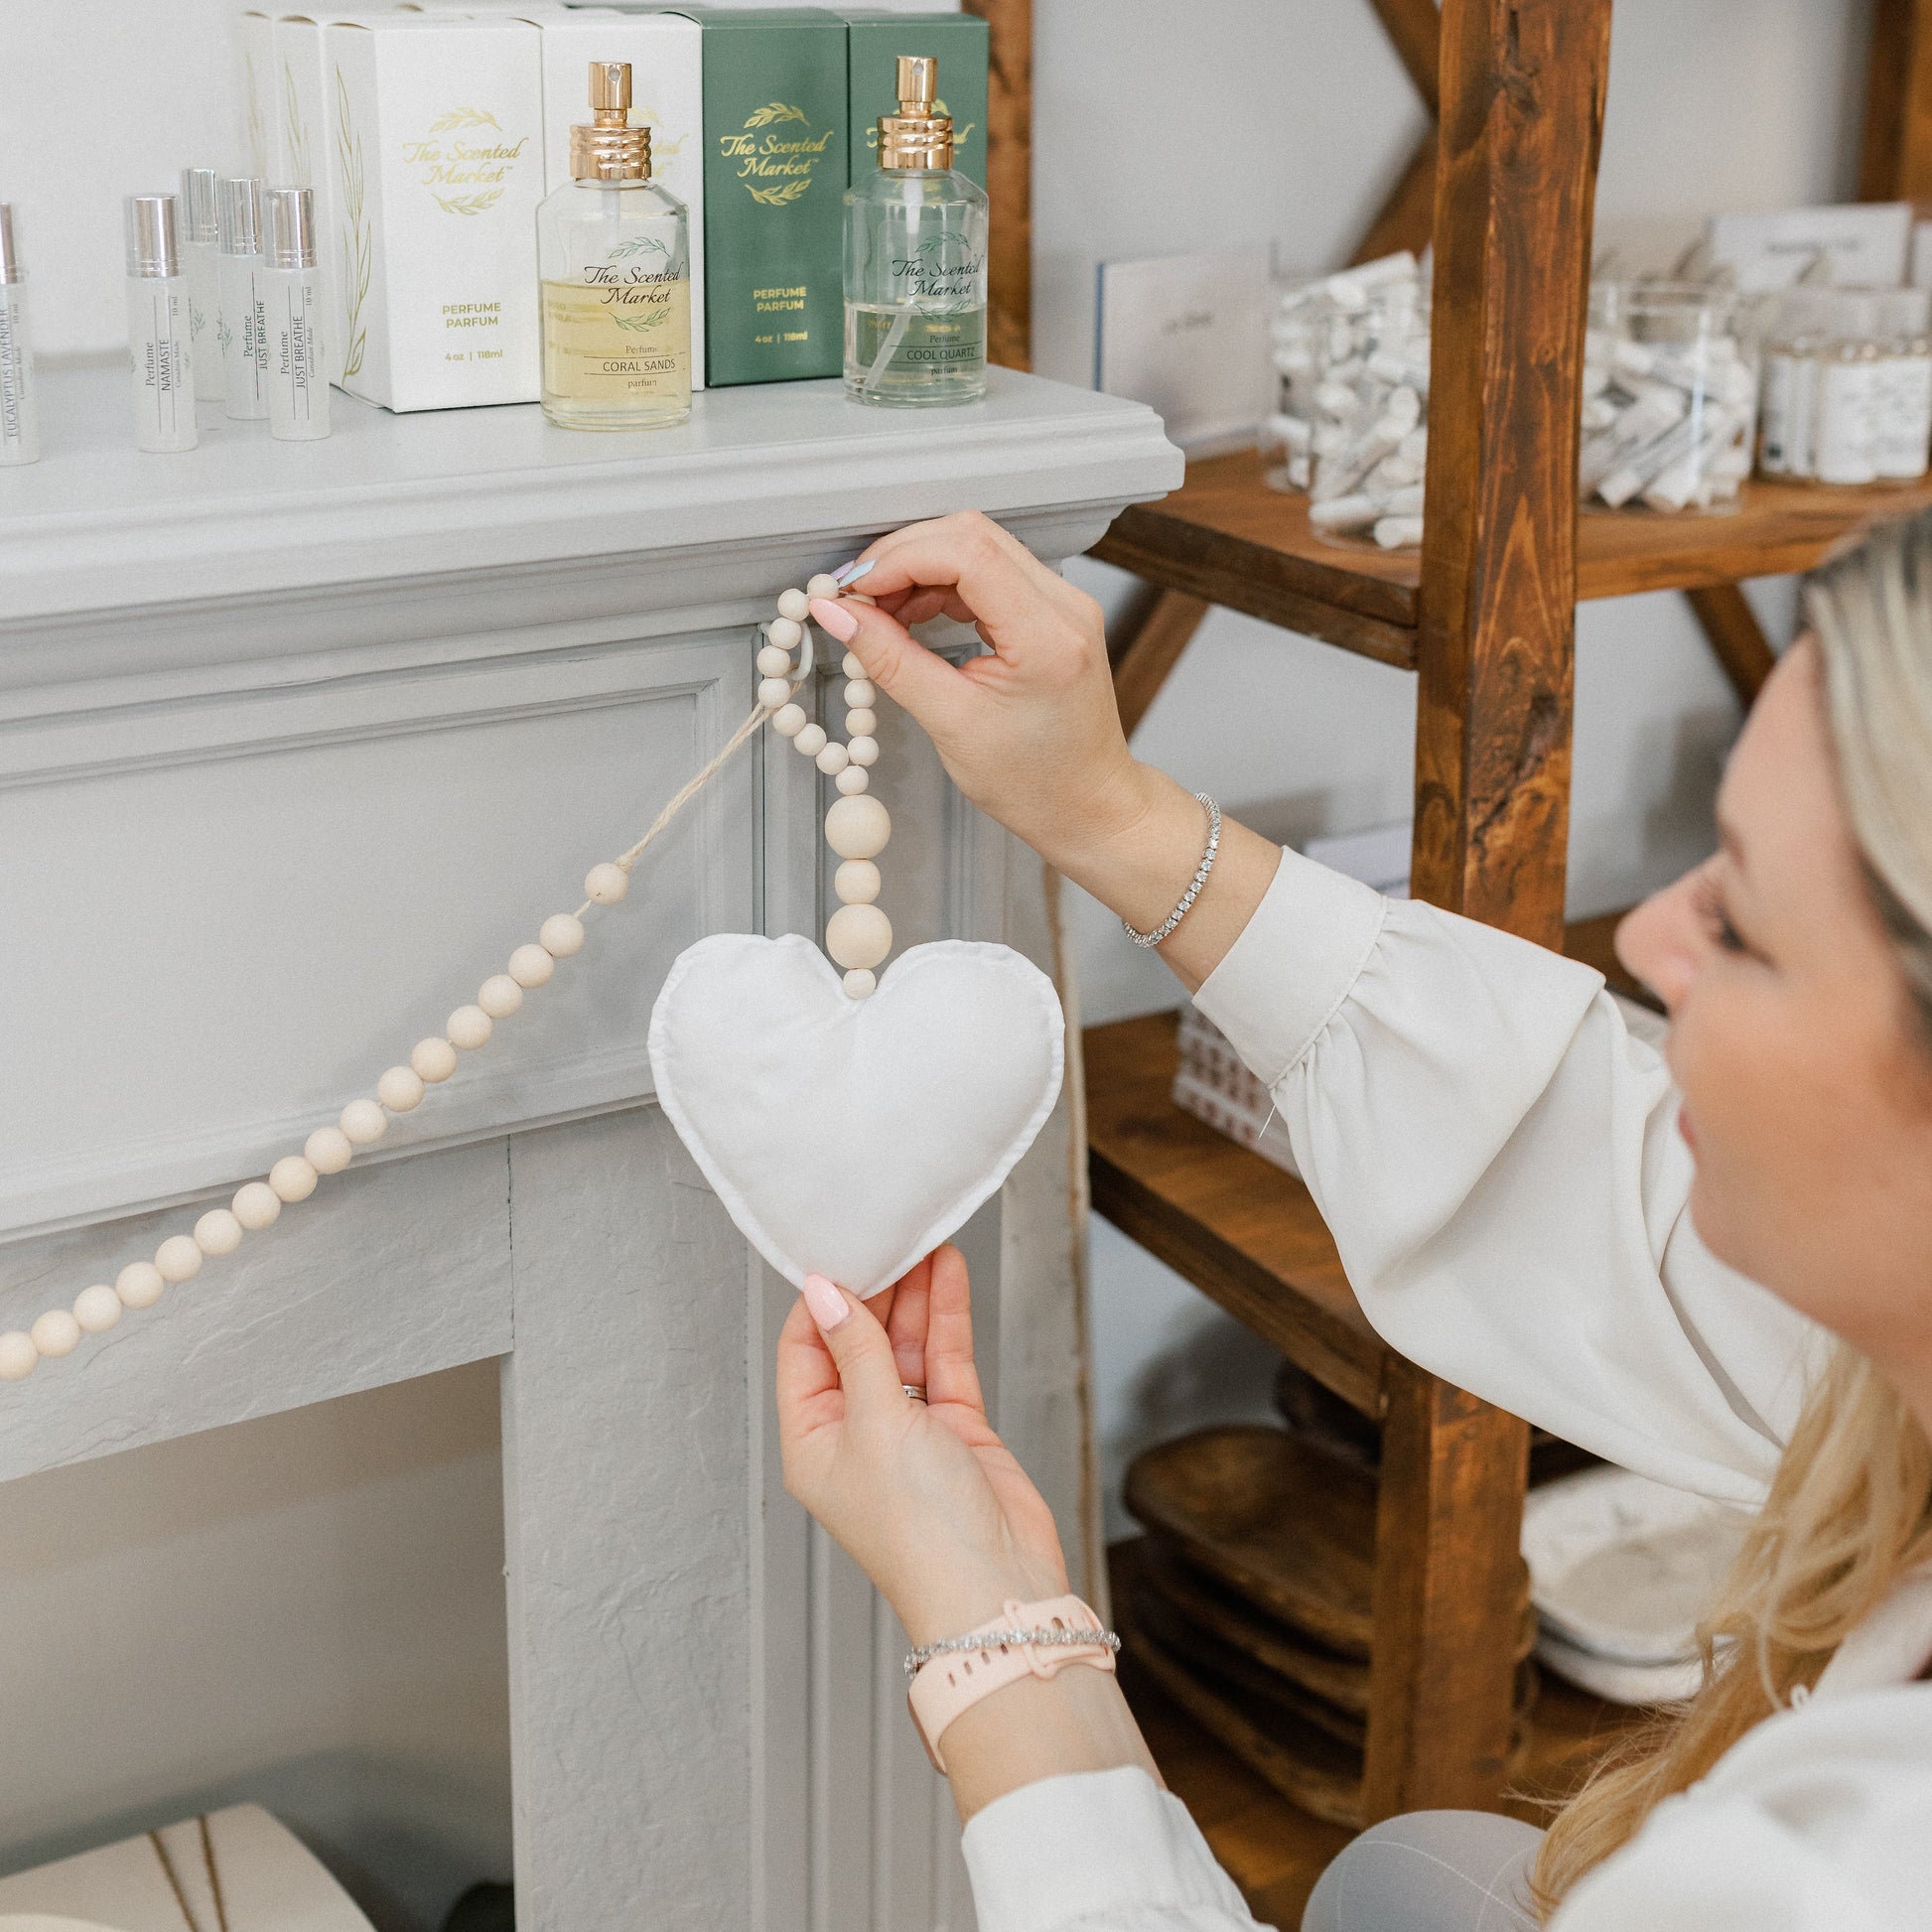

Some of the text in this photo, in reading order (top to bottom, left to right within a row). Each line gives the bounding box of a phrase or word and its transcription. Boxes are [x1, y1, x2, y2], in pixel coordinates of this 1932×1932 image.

[401, 137, 529, 164] The Scented
[720, 130, 834, 157] The Scented
[584, 261, 684, 285] The Scented
[892, 258, 924, 277] The
[600, 284, 671, 305] Market
[754, 286, 807, 300] PERFUME
[908, 277, 972, 296] Market
[442, 302, 501, 315] PERFUME
[757, 299, 804, 313] PARFUM
[446, 316, 498, 329] PARFUM
[242, 316, 253, 357] Perfume
[256, 300, 268, 370] JUST BREATHE
[280, 332, 290, 374] Perfume
[293, 316, 306, 388] JUST BREATHE
[445, 352, 452, 361] 4
[906, 346, 975, 360] COOL QUARTZ
[145, 343, 156, 386] Perfume
[159, 339, 171, 391] NAMASTE
[603, 358, 676, 372] CORAL SANDS
[3, 368, 17, 437] EUCALYPTUS
